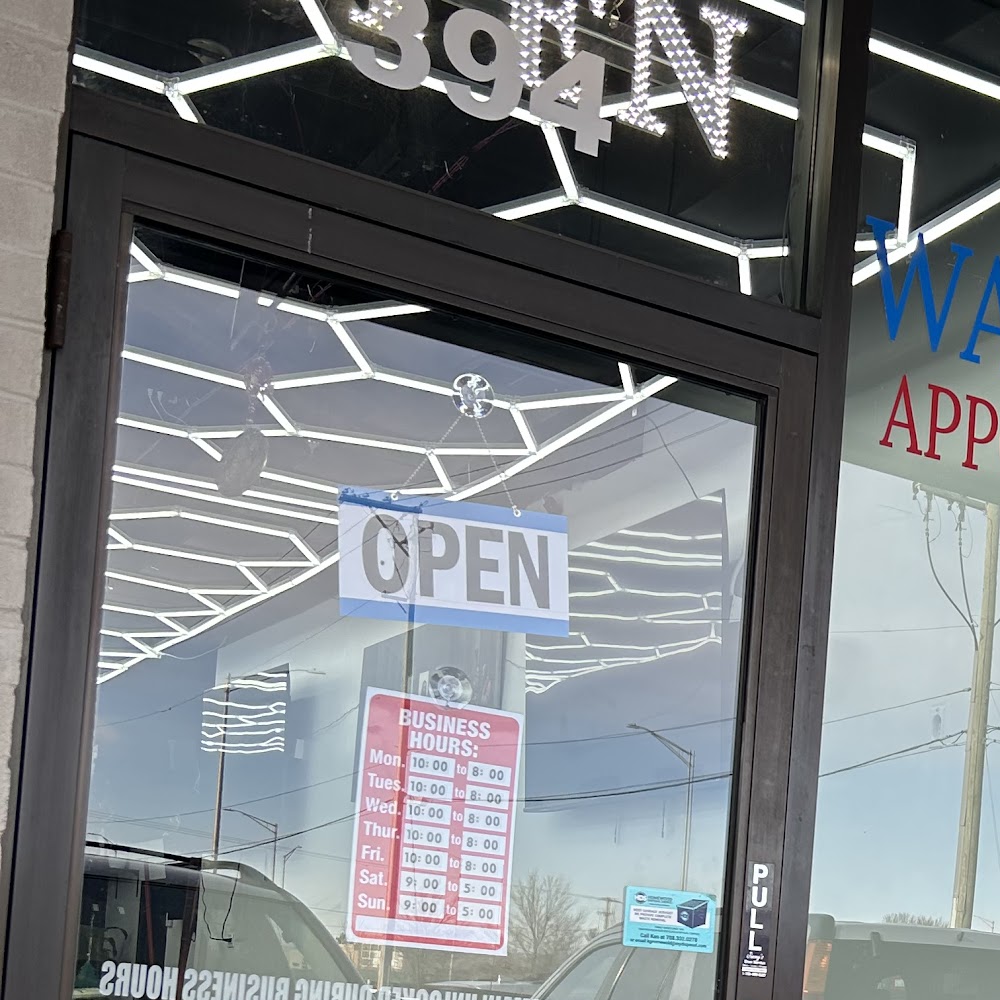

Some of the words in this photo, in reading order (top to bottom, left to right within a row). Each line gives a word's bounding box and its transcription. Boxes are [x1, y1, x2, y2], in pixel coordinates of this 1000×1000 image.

[345, 0, 612, 158] 394
[362, 513, 551, 610] OPEN
[398, 708, 491, 740] BUSINESS
[409, 731, 479, 758] HOURS:
[369, 748, 405, 768] Mon.
[457, 763, 466, 775] to
[367, 773, 405, 792] Tues.
[455, 787, 465, 799] to
[365, 796, 402, 815] Wed.
[453, 810, 463, 822] to
[363, 821, 400, 839] Thur.
[451, 834, 461, 846] to
[361, 845, 384, 862] Fri.
[449, 857, 460, 869] to
[359, 869, 388, 887] Sat.
[447, 880, 458, 892] to
[357, 893, 390, 911] Sun.
[446, 904, 457, 916] to
[748, 863, 769, 952] PULL
